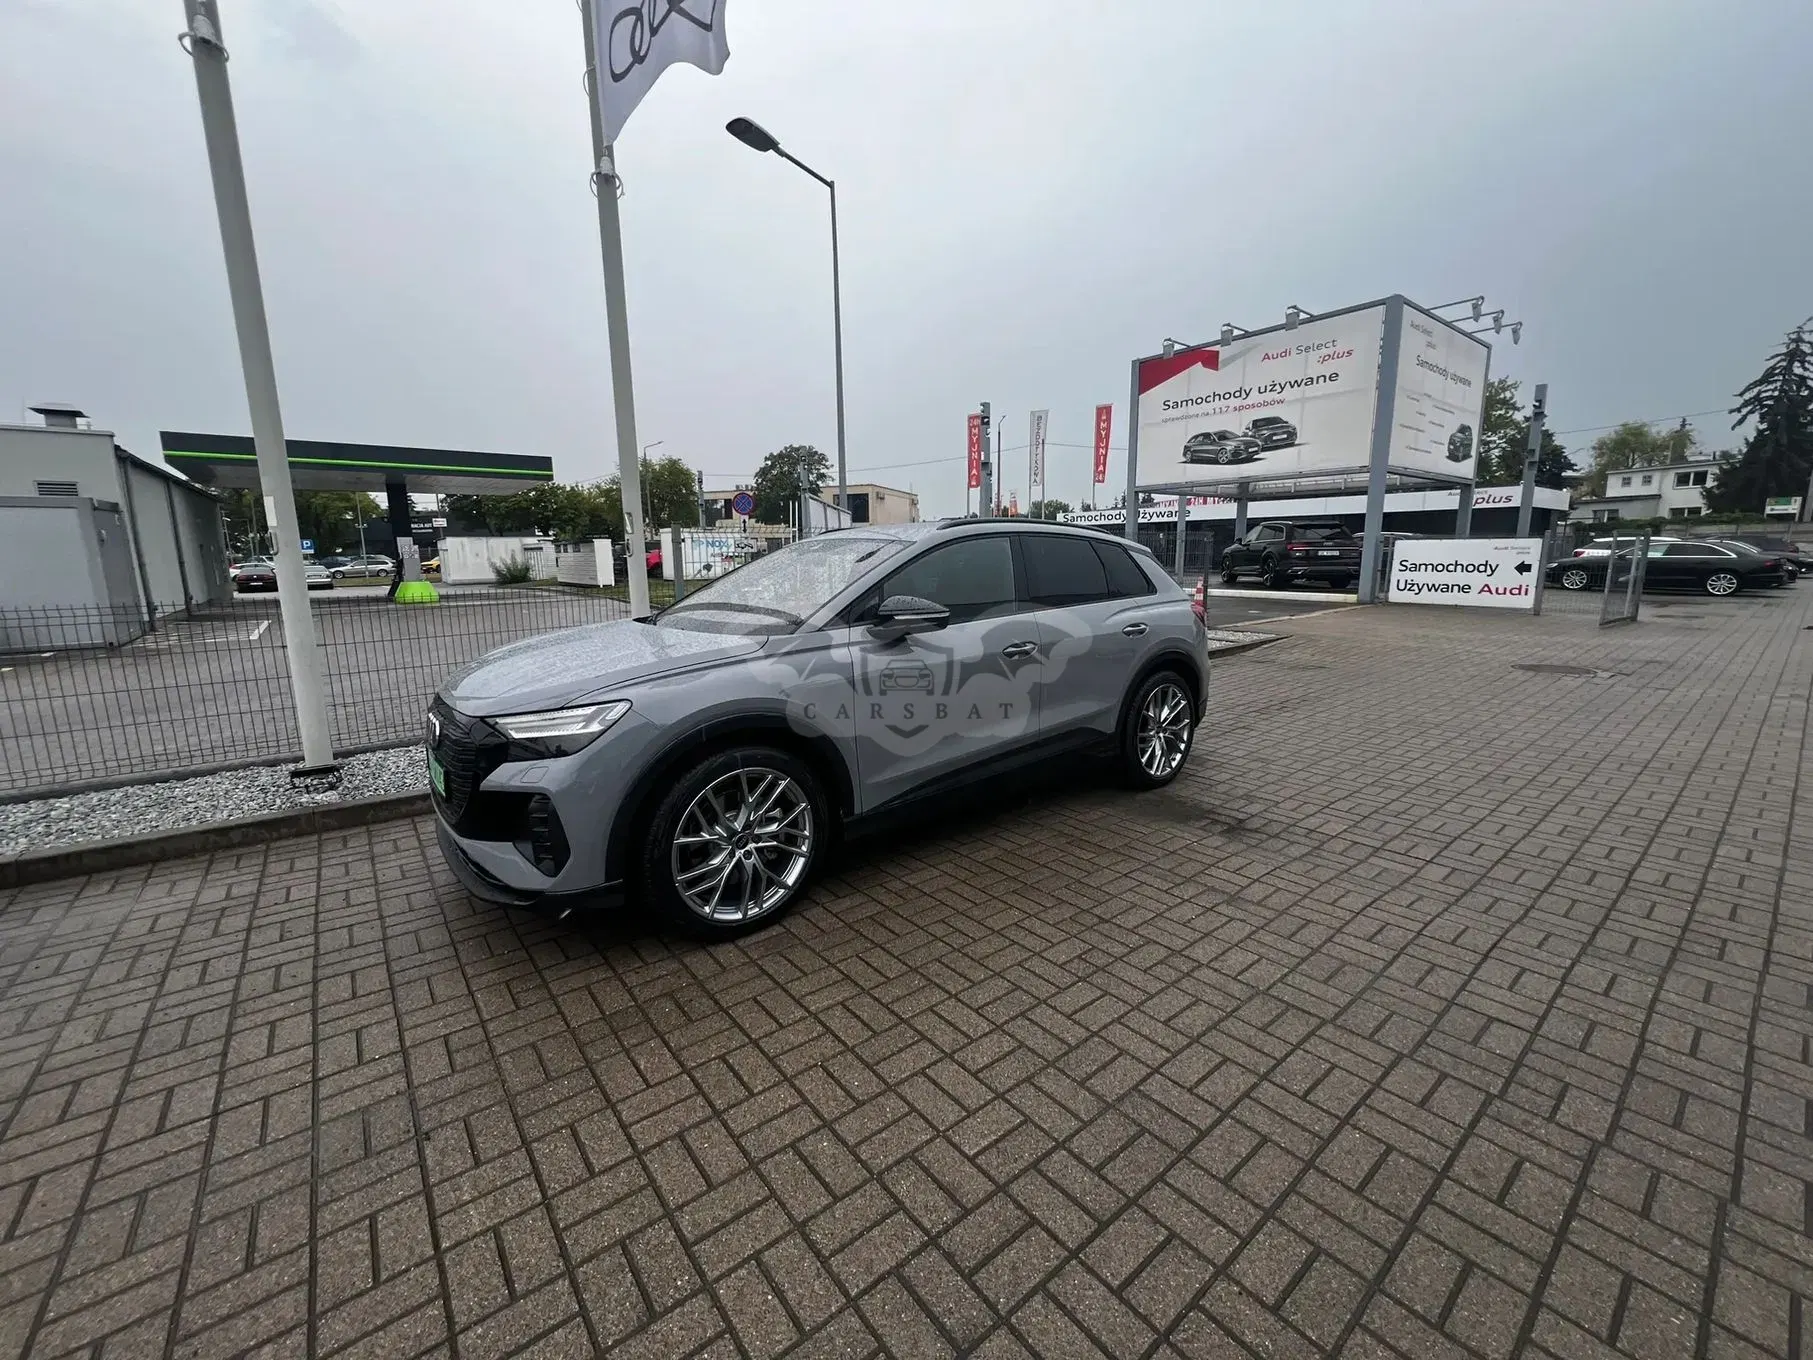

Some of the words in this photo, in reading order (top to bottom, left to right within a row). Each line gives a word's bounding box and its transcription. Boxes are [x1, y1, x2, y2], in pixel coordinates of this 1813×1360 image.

[1261, 348, 1292, 362] Audi
[1295, 339, 1338, 355] Select
[1161, 387, 1253, 412] Samochody
[1257, 371, 1340, 395] używane
[1212, 406, 1230, 415] 117
[1232, 398, 1286, 412] sposobów
[971, 427, 979, 476] MYJNIA
[1097, 421, 1107, 472] MYJNIA
[1473, 494, 1514, 507] plus
[1063, 511, 1127, 523] Samochody
[1138, 509, 1191, 521] żywae
[303, 540, 311, 549] P
[1398, 559, 1499, 577] Samochody
[1396, 579, 1472, 595] Używane
[1478, 583, 1530, 596] Audi
